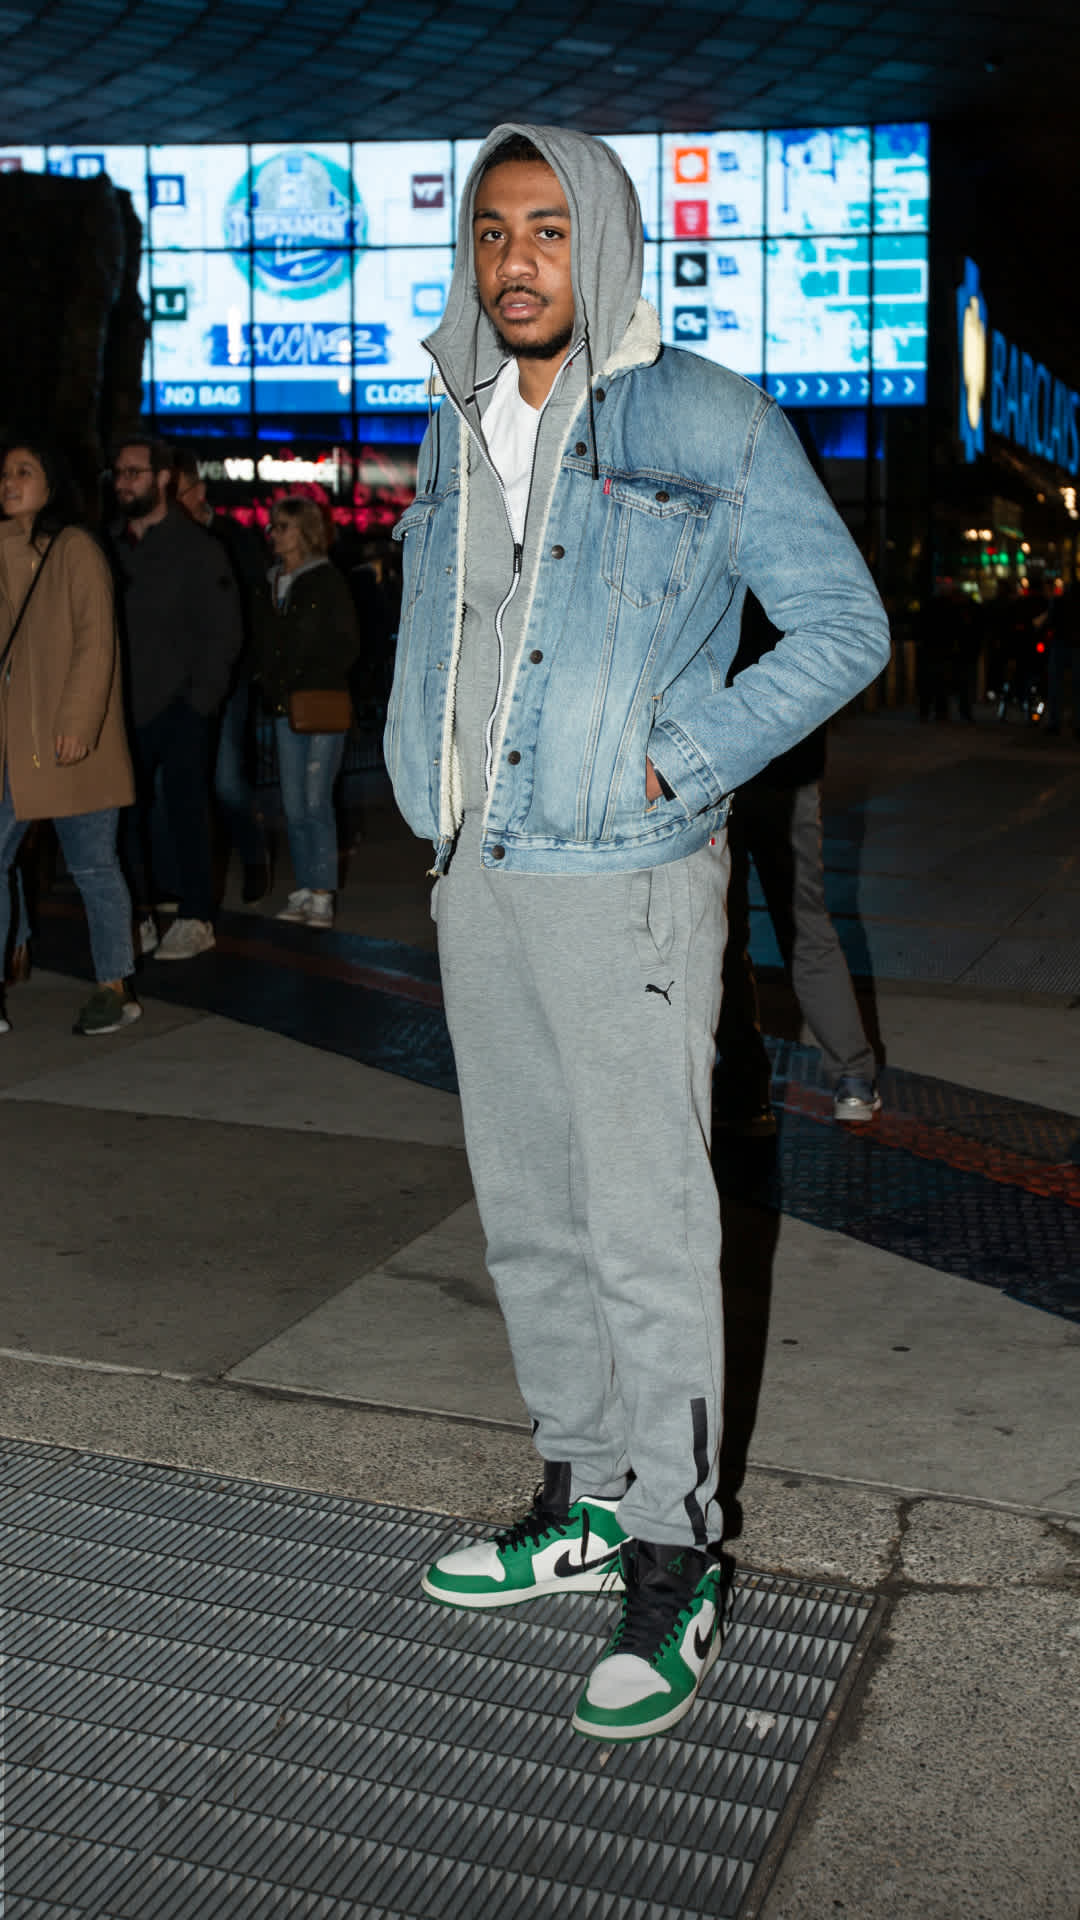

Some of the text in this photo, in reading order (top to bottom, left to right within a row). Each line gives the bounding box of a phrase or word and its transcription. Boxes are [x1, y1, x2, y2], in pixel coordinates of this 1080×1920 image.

[165, 385, 241, 406] NO BAG
[364, 383, 442, 405] CLOSE
